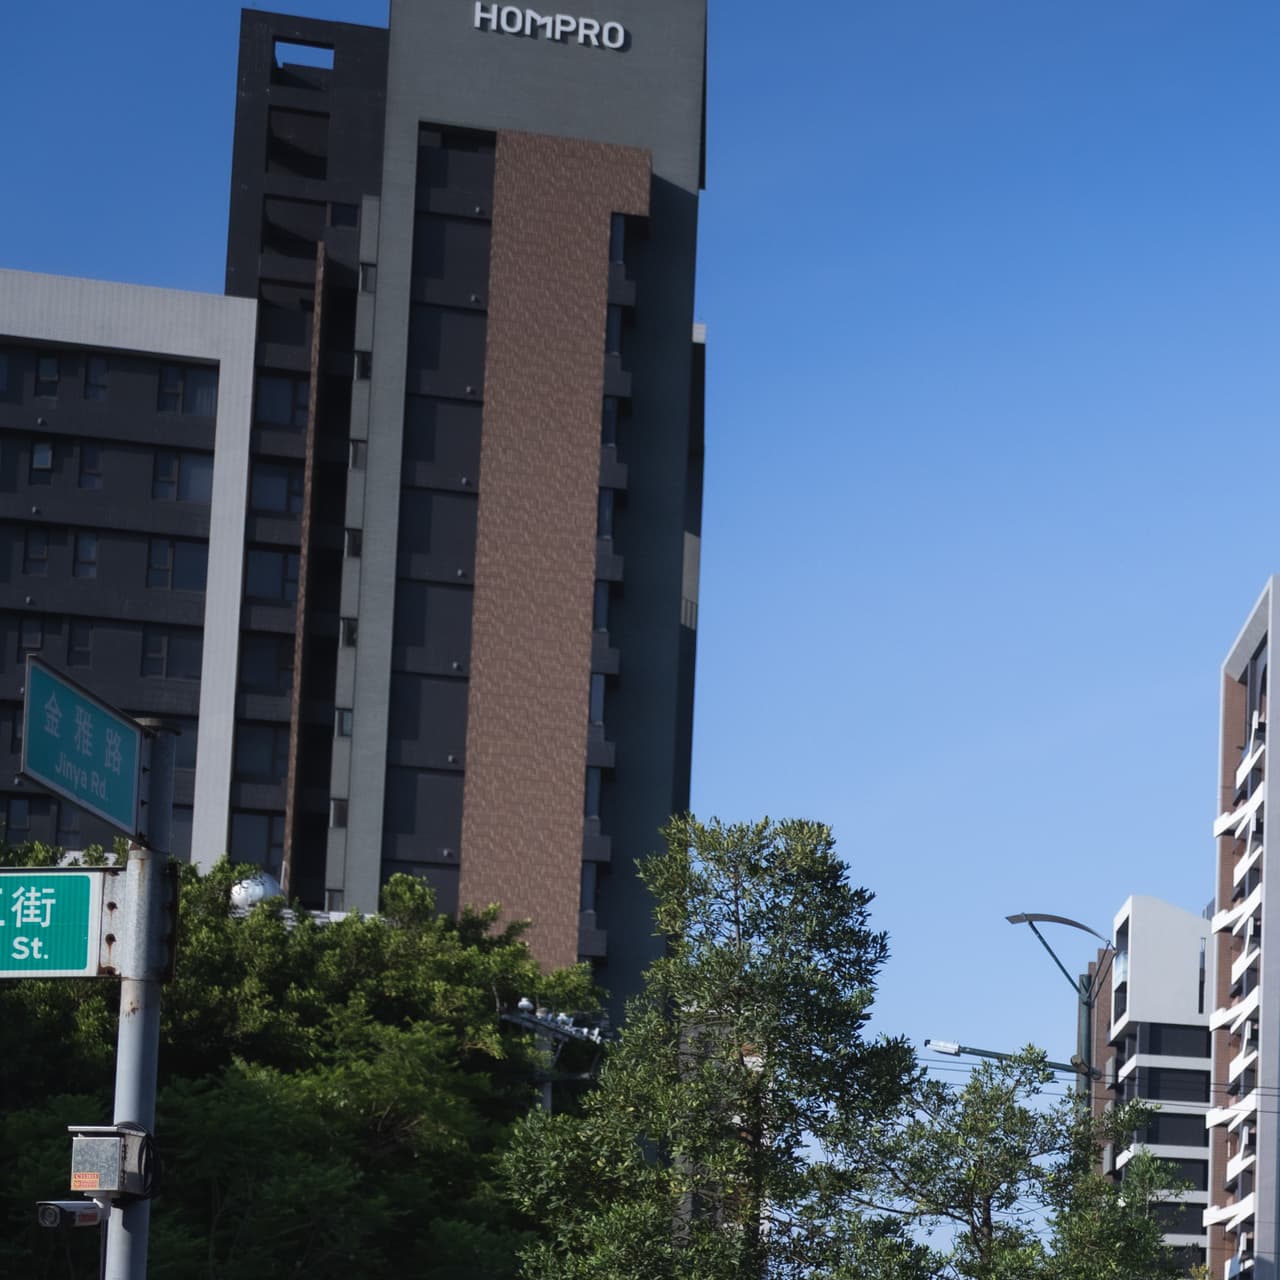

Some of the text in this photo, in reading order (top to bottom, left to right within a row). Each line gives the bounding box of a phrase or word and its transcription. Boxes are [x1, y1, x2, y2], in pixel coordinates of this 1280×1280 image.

[474, 1, 625, 49] HOMPRO
[44, 691, 123, 775] 金雅路
[55, 752, 88, 790] Jinya
[0, 886, 56, 928] 街
[12, 936, 49, 960] St.
